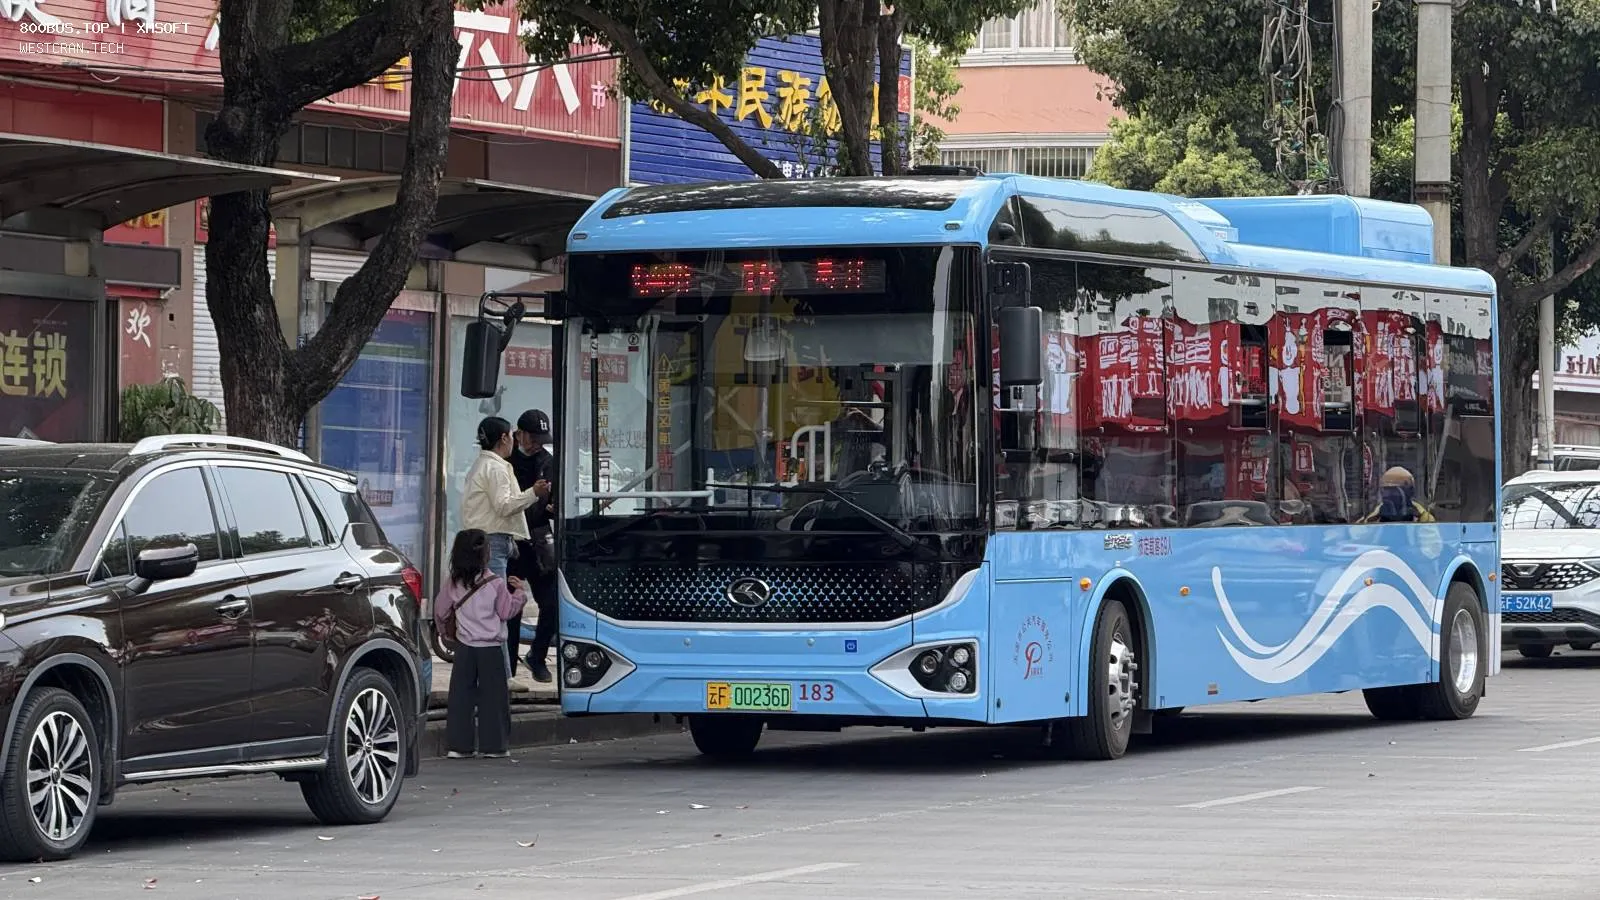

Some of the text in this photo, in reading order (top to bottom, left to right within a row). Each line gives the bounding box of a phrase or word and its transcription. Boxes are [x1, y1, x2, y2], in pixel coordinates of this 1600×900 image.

[126, 306, 152, 348] 欢
[0, 332, 67, 399] 连锁
[799, 683, 835, 702] 183
